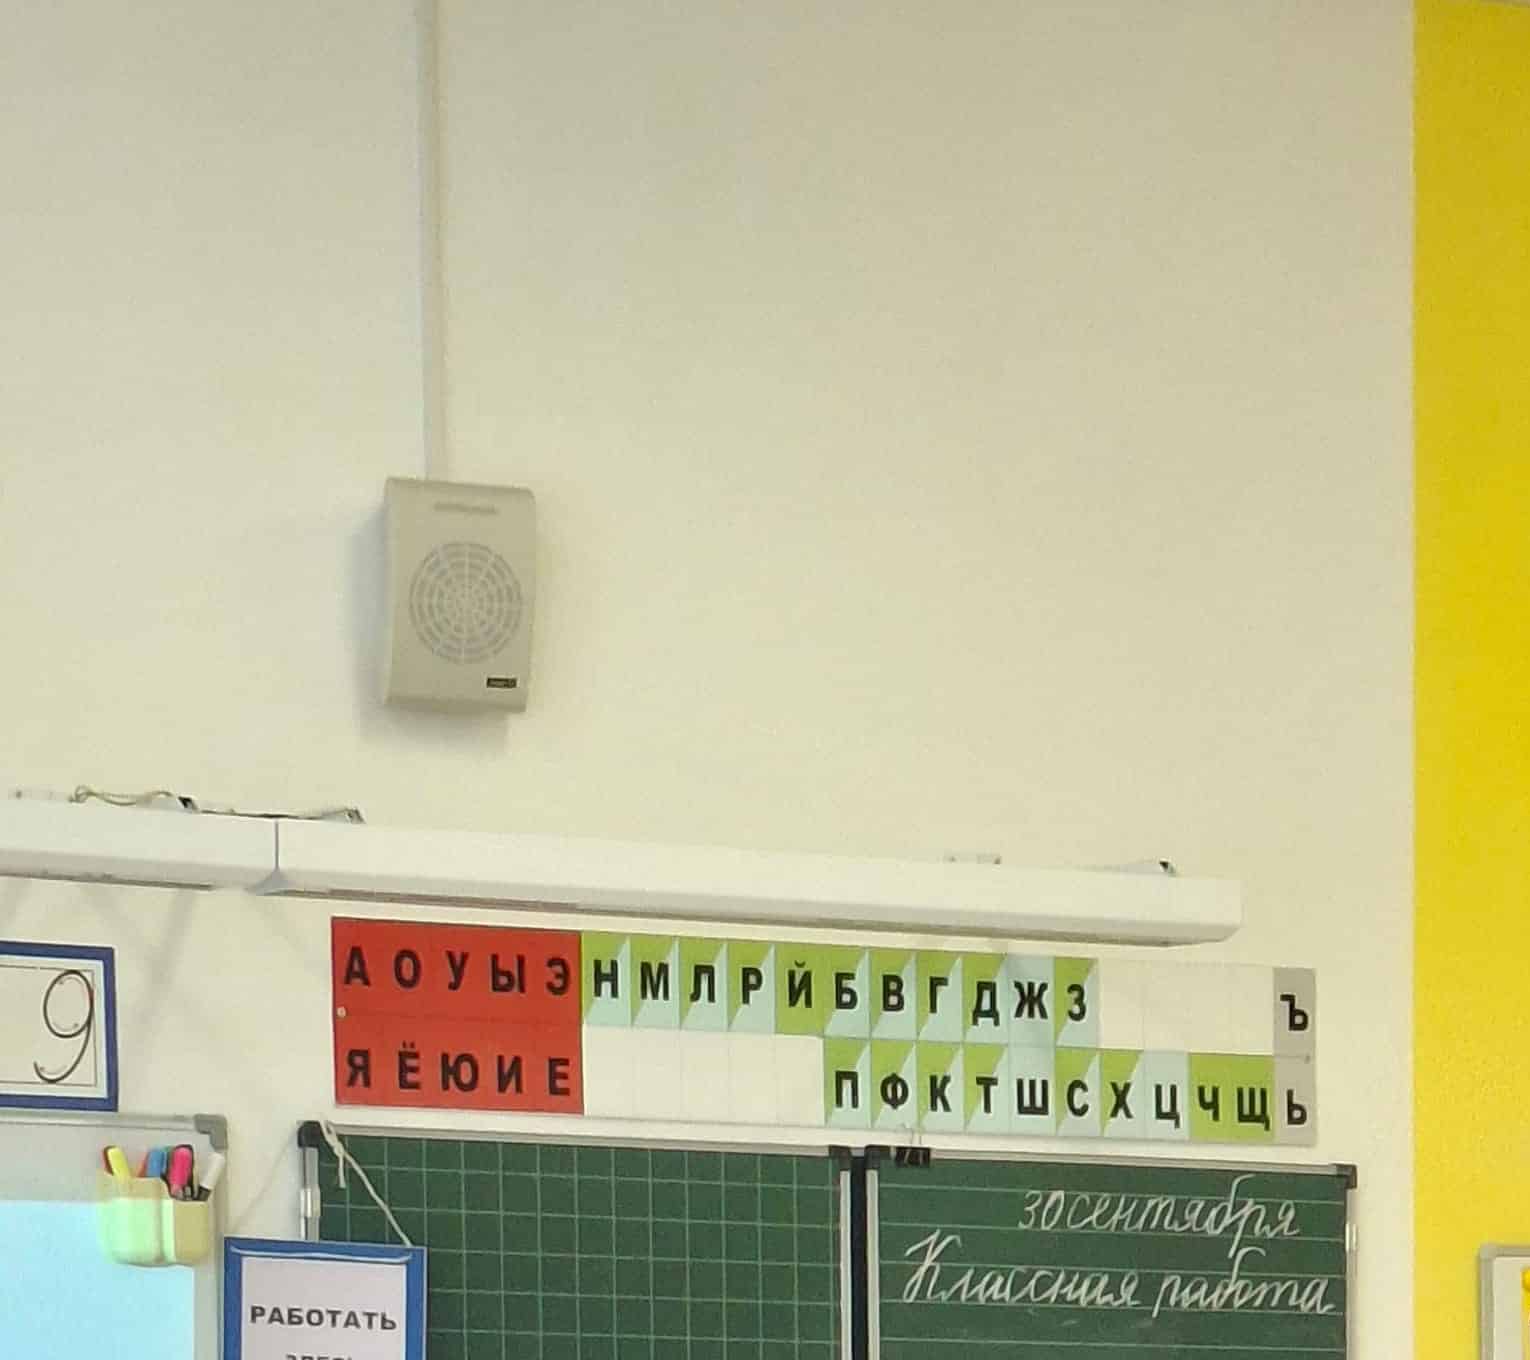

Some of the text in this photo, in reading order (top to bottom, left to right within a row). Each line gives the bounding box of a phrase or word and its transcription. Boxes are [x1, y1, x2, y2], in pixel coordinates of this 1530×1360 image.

[33, 968, 95, 1084] 9
[344, 946, 1309, 1032] А О У Ы Э Н М Л Р Й Б В Г Д Ж З Ъ
[347, 1042, 1308, 1131] Я Ё Ю И Е П Ф К Т Ш С Х Ц Ч Щ Ь
[1067, 1174, 1300, 1258] сентября
[903, 1229, 1336, 1319] Классная работа
[249, 1304, 398, 1332] РАБОТАТЬ
